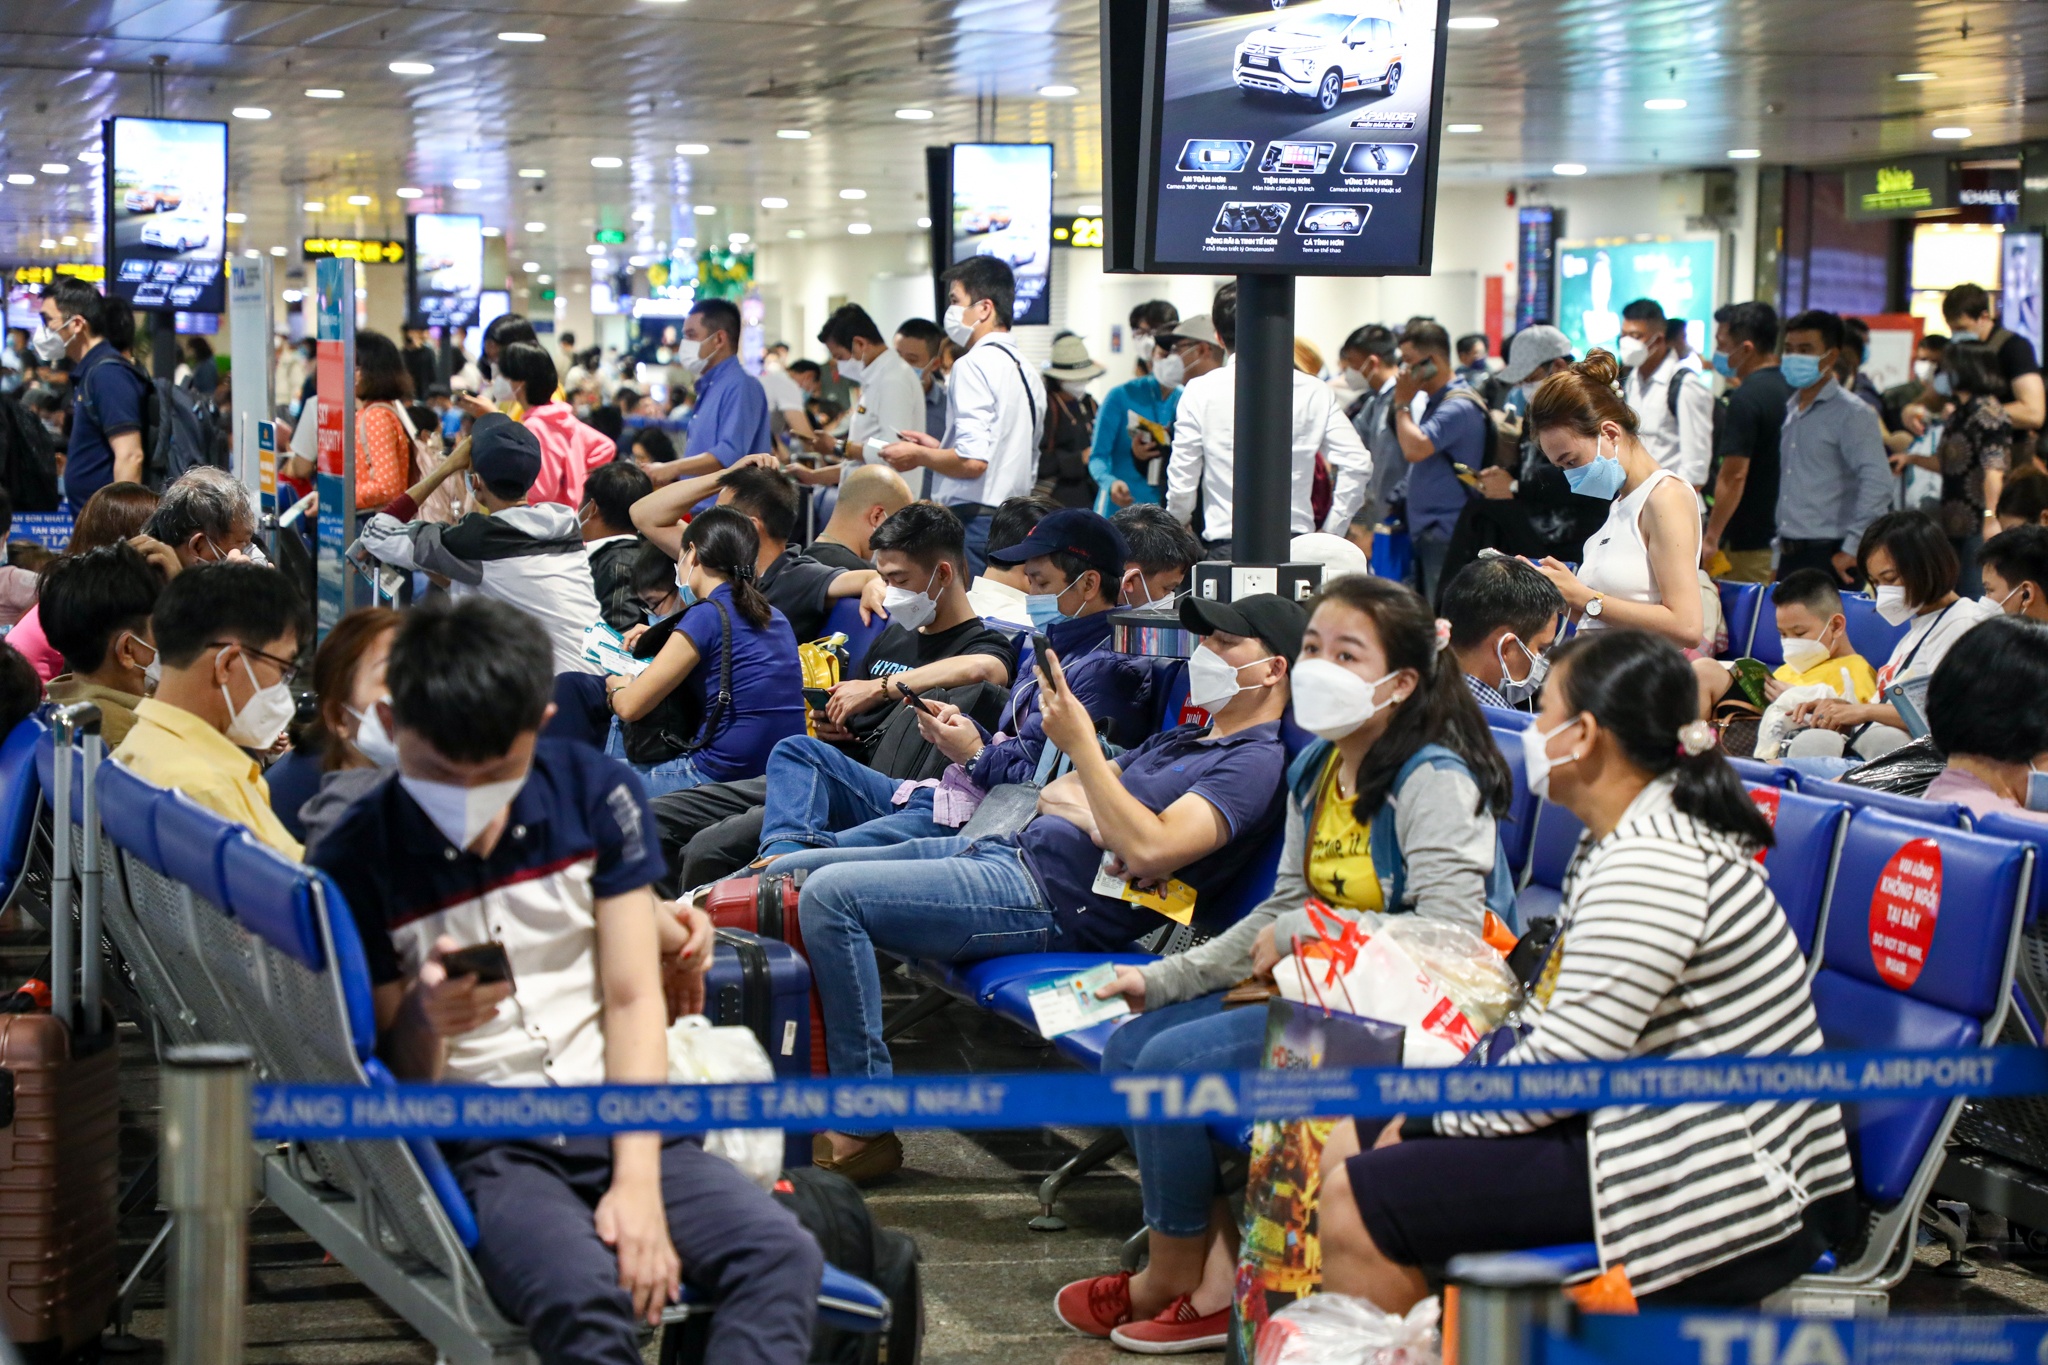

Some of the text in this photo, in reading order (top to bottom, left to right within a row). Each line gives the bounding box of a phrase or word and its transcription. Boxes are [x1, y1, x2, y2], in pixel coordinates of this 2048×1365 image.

[31, 526, 48, 535] TAN
[1111, 1073, 1238, 1120] TIA
[1377, 1071, 1438, 1103] TAN
[1445, 1070, 1515, 1101] SON
[1518, 1067, 1604, 1099] NHAT
[1610, 1061, 1856, 1098] INTERNATIONAL
[1859, 1056, 1999, 1089] AIRPORT
[1679, 1316, 1850, 1365] TIA
